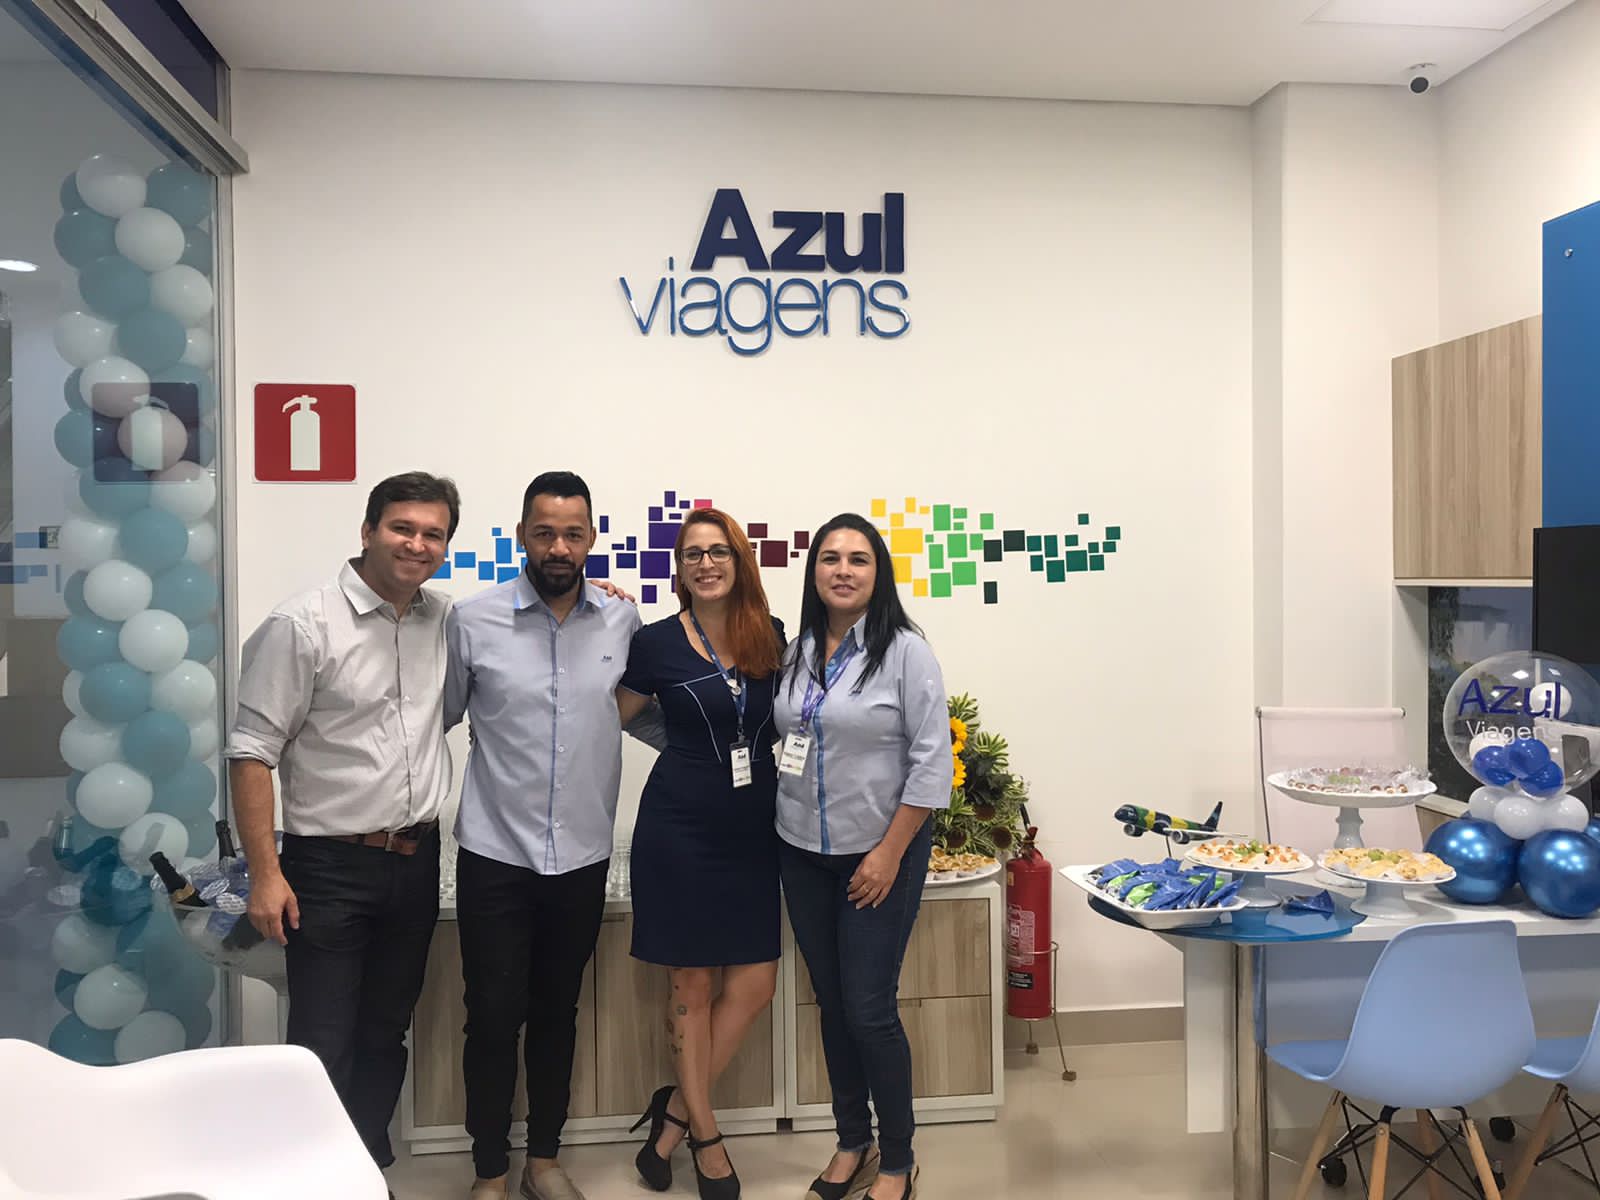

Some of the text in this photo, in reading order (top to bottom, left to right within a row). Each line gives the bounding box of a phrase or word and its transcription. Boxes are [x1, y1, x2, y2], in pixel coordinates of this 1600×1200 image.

[690, 188, 904, 274] Azul
[619, 256, 910, 356] viagens
[1458, 678, 1561, 720] Azul
[1466, 719, 1556, 745] Viagen
